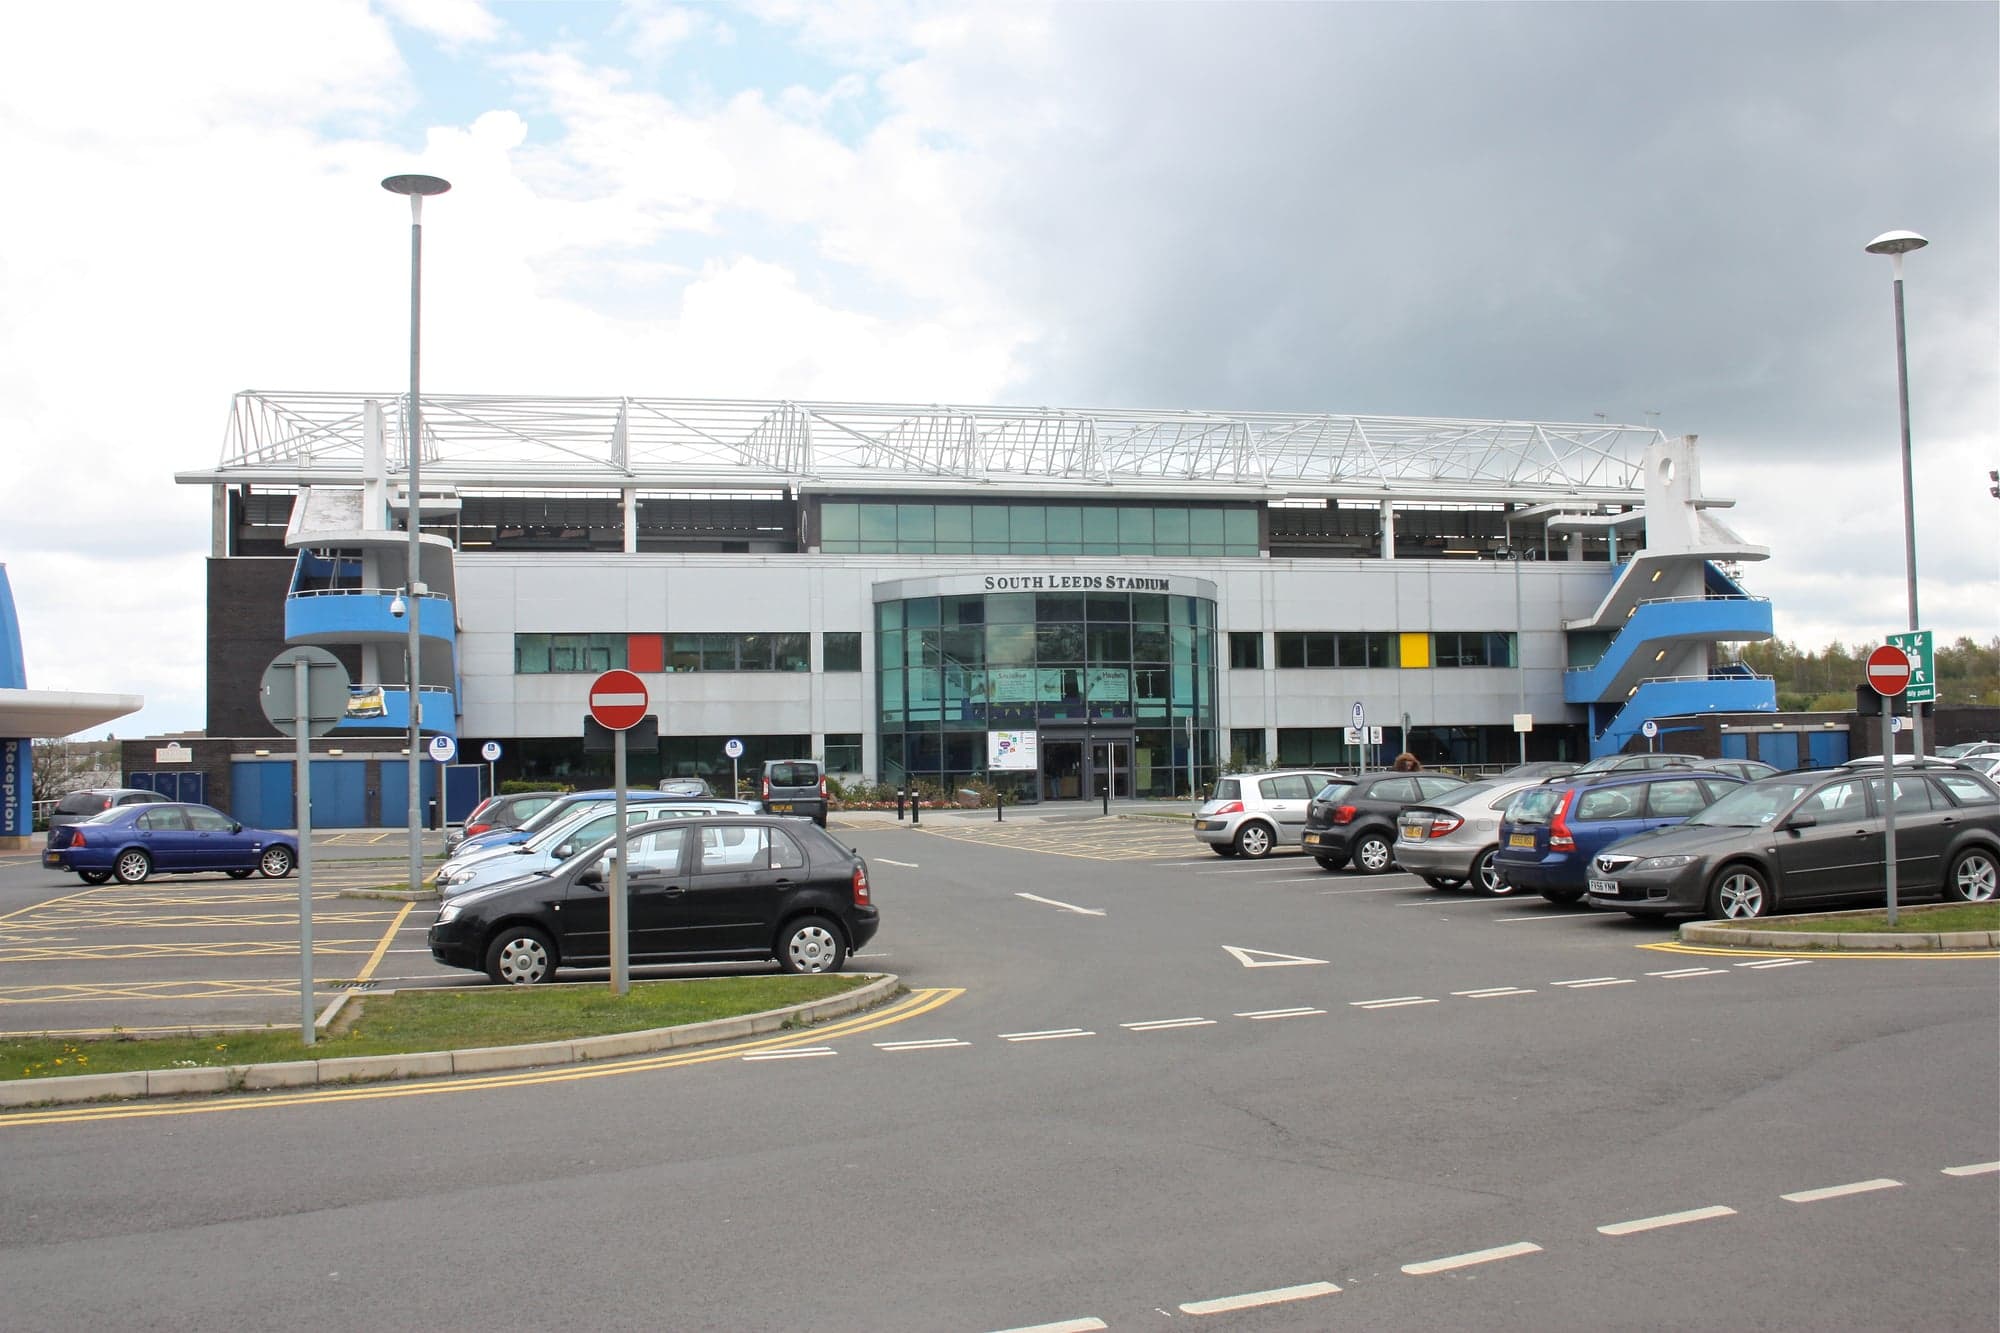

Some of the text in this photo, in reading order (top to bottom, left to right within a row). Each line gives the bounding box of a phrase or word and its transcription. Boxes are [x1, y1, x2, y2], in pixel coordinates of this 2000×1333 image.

[985, 575, 1169, 591] SOUTH LEEDS STADIUM
[2, 741, 18, 832] Reception
